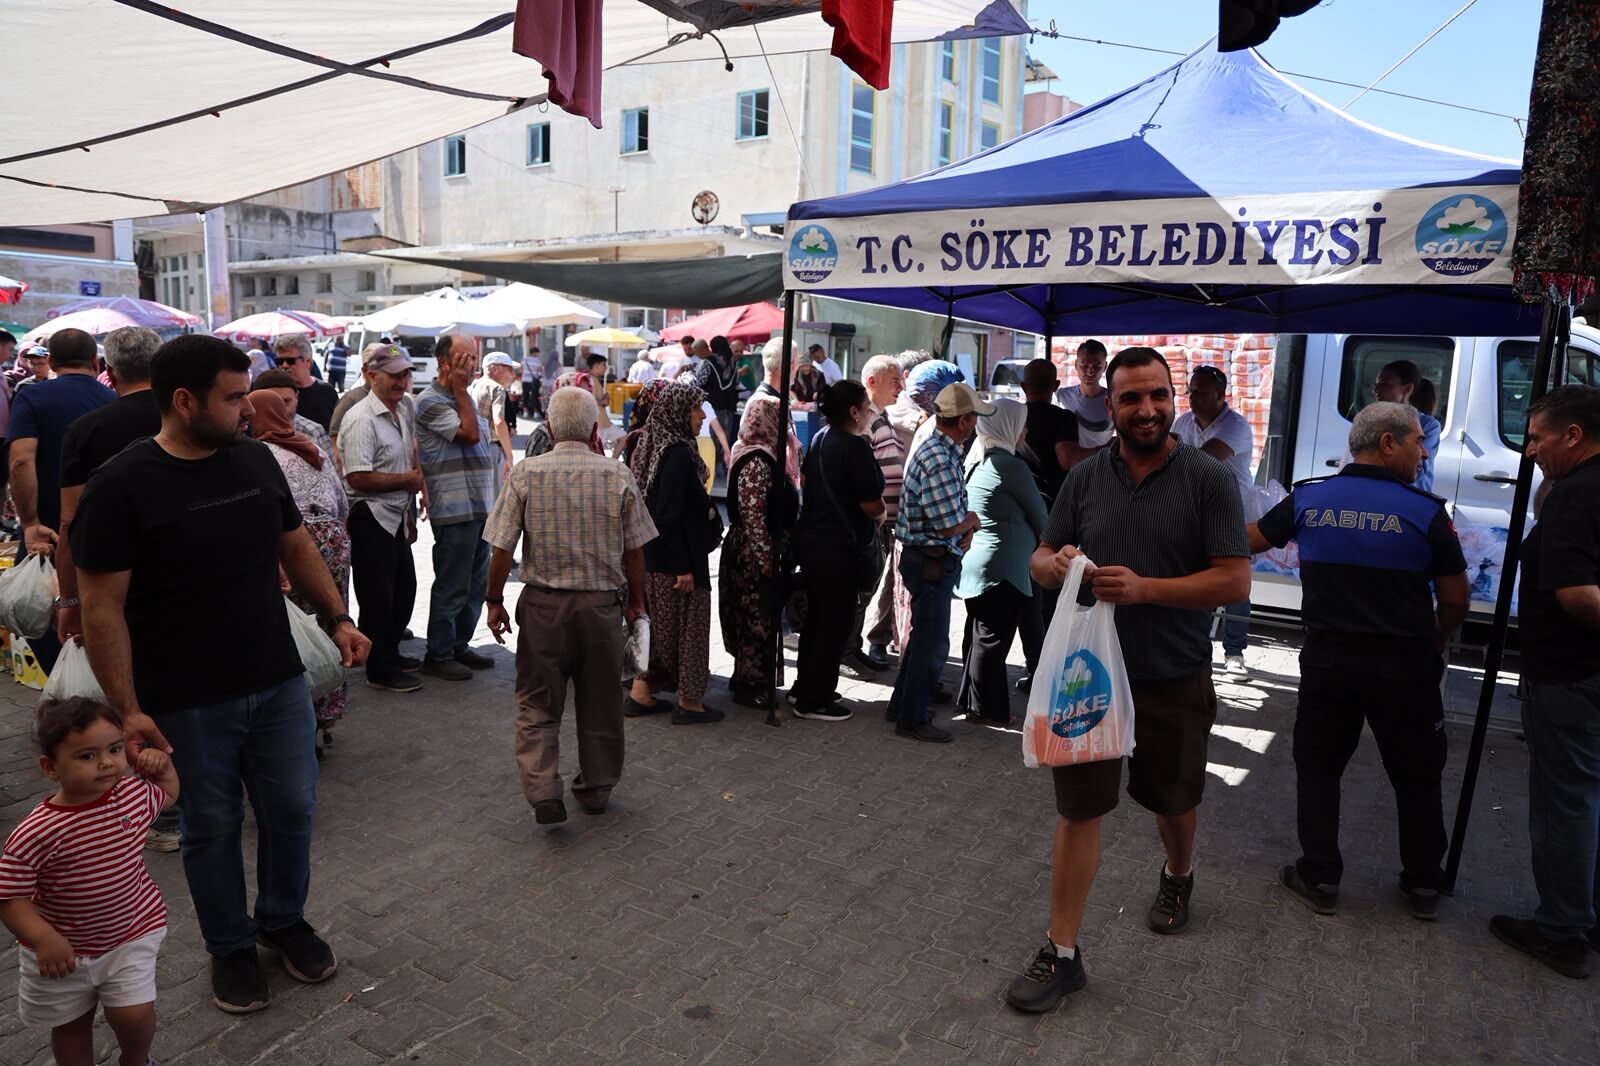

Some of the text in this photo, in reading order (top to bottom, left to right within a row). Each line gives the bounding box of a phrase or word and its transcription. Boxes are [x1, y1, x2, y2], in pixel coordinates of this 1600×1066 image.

[856, 202, 1387, 274] T.C. SÖKE BELEDİYESİ
[1420, 238, 1502, 257] SÖKE
[791, 256, 836, 268] SÖKE
[1434, 260, 1480, 274] Belediyesi
[1304, 508, 1403, 534] ZABITA
